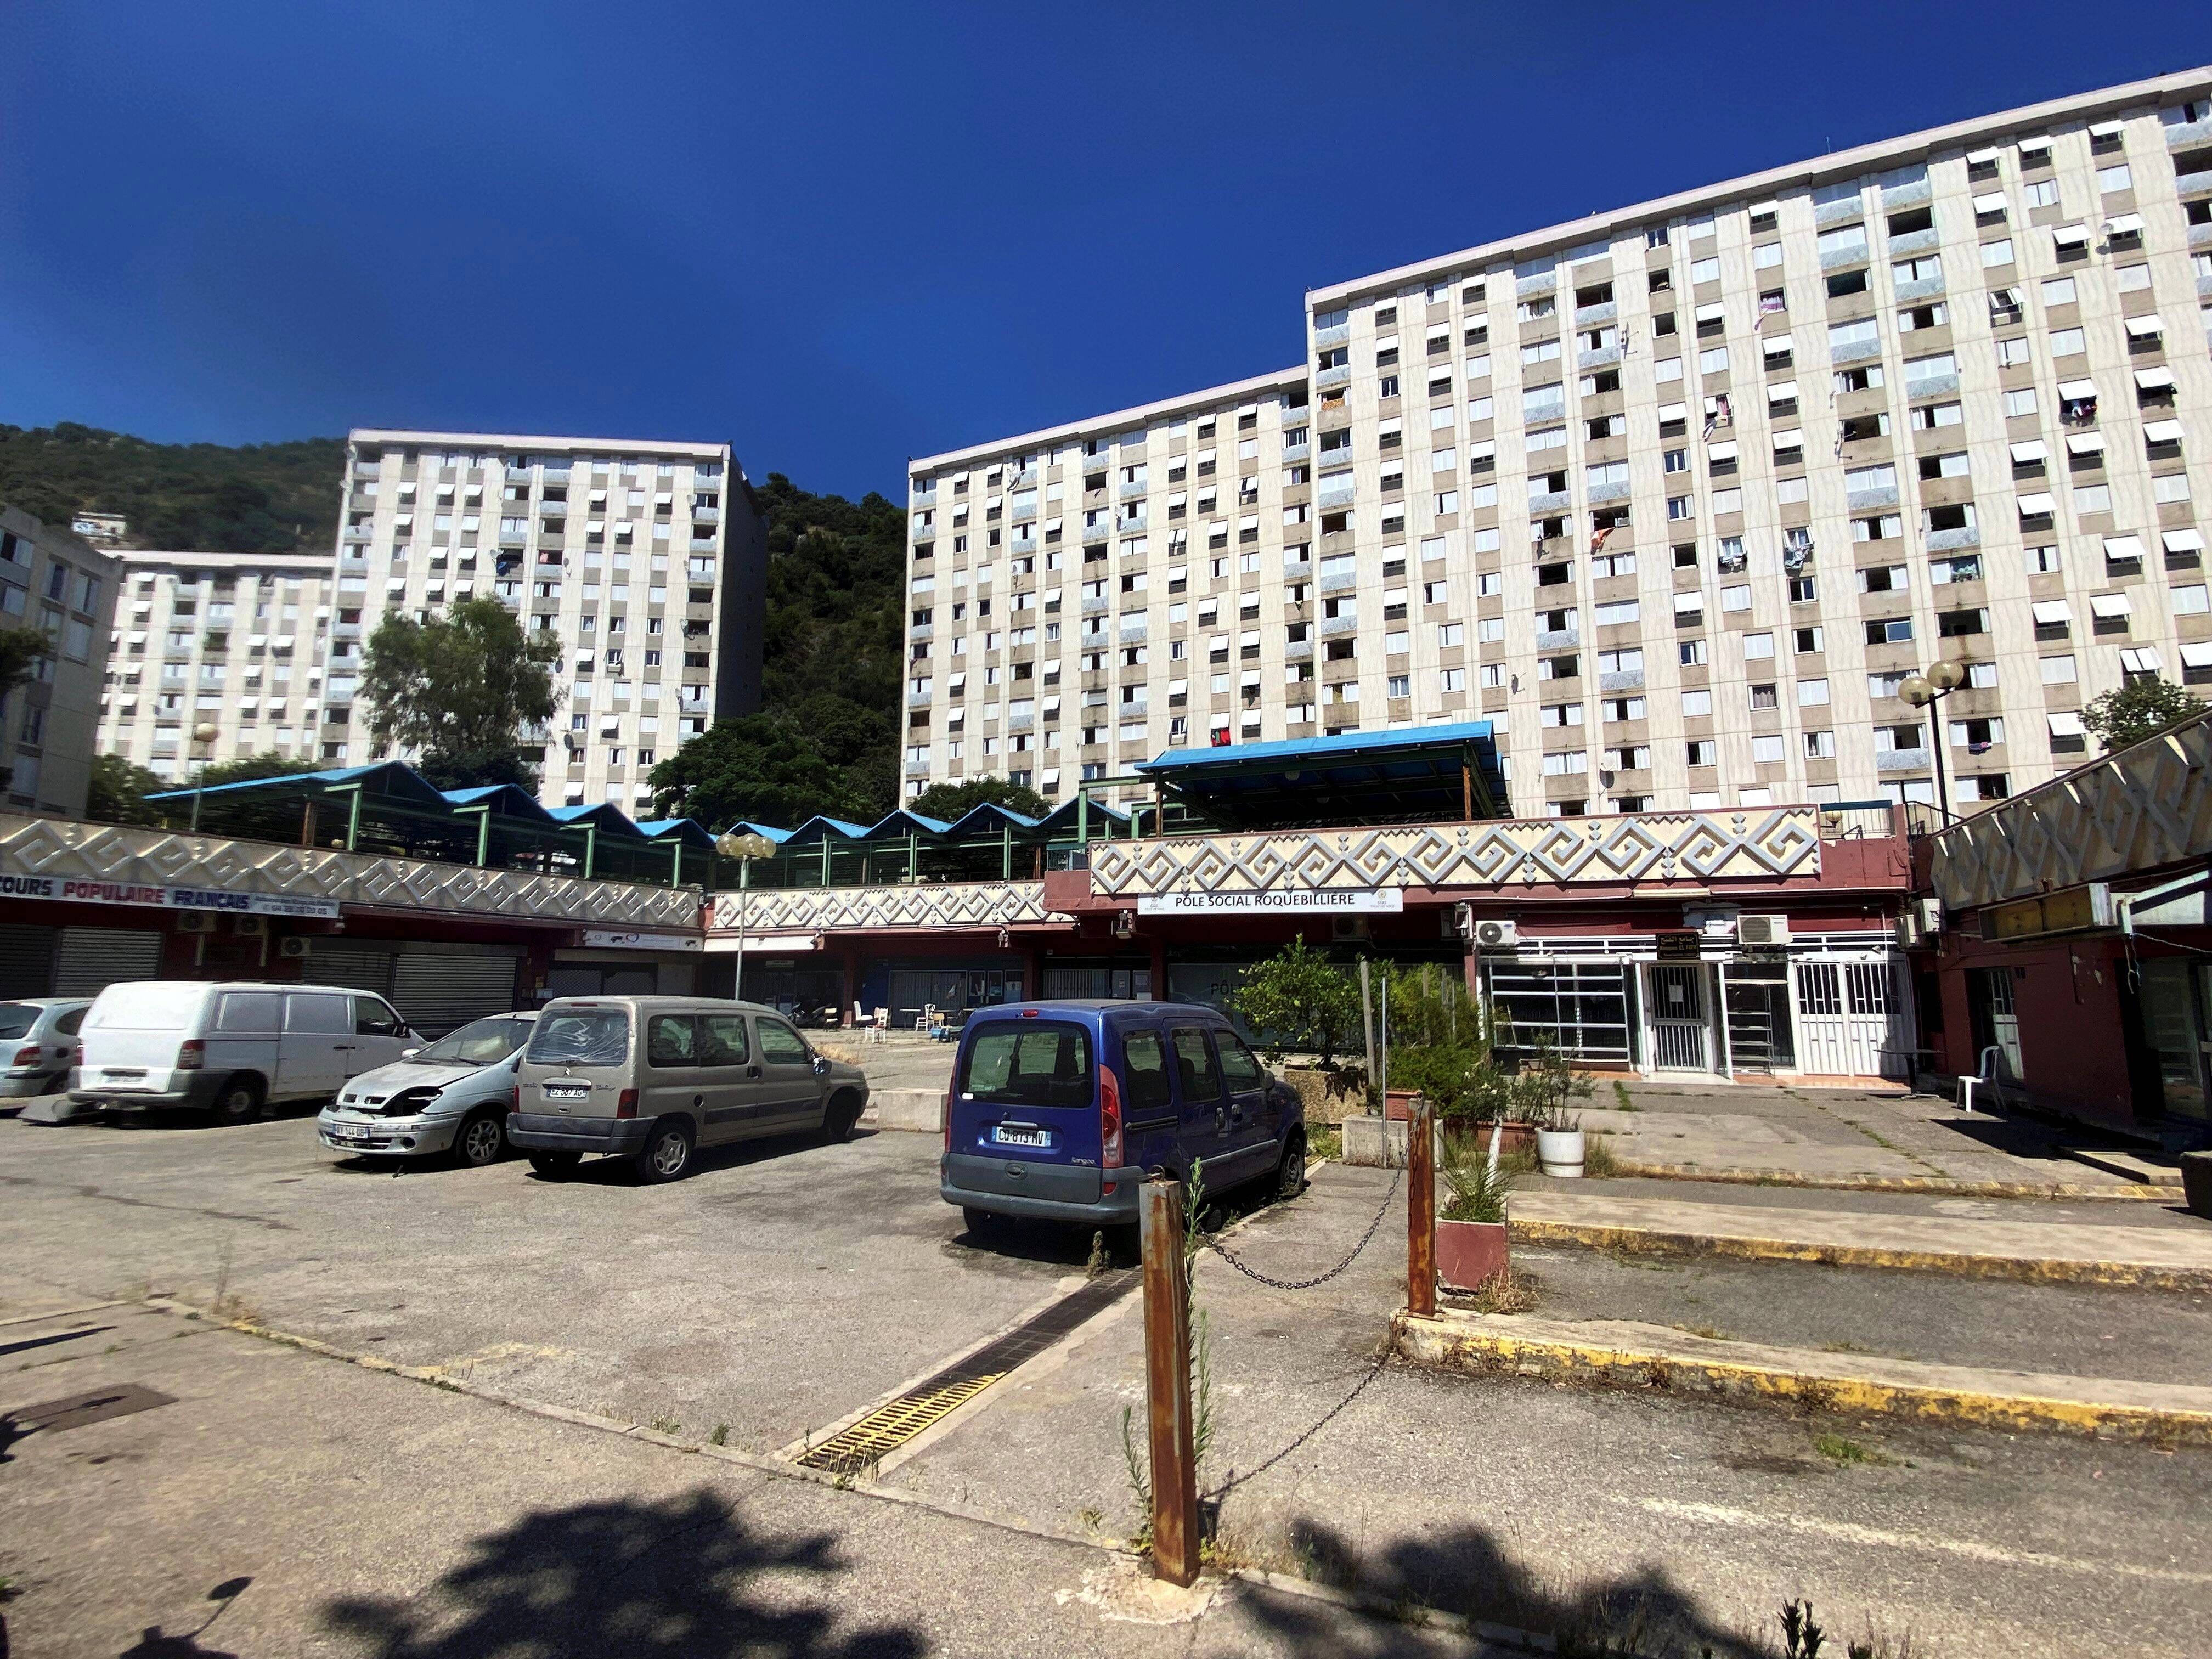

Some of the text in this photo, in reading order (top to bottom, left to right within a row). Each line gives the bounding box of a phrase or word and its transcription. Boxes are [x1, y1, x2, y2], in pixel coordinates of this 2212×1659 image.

[0, 876, 53, 896] OURS
[62, 881, 166, 904] POPULAIRE
[174, 890, 250, 910] FRANÇAIS
[1208, 895, 1251, 906] SOCIAL
[1255, 893, 1355, 907] ROQUEBILLIÈRE
